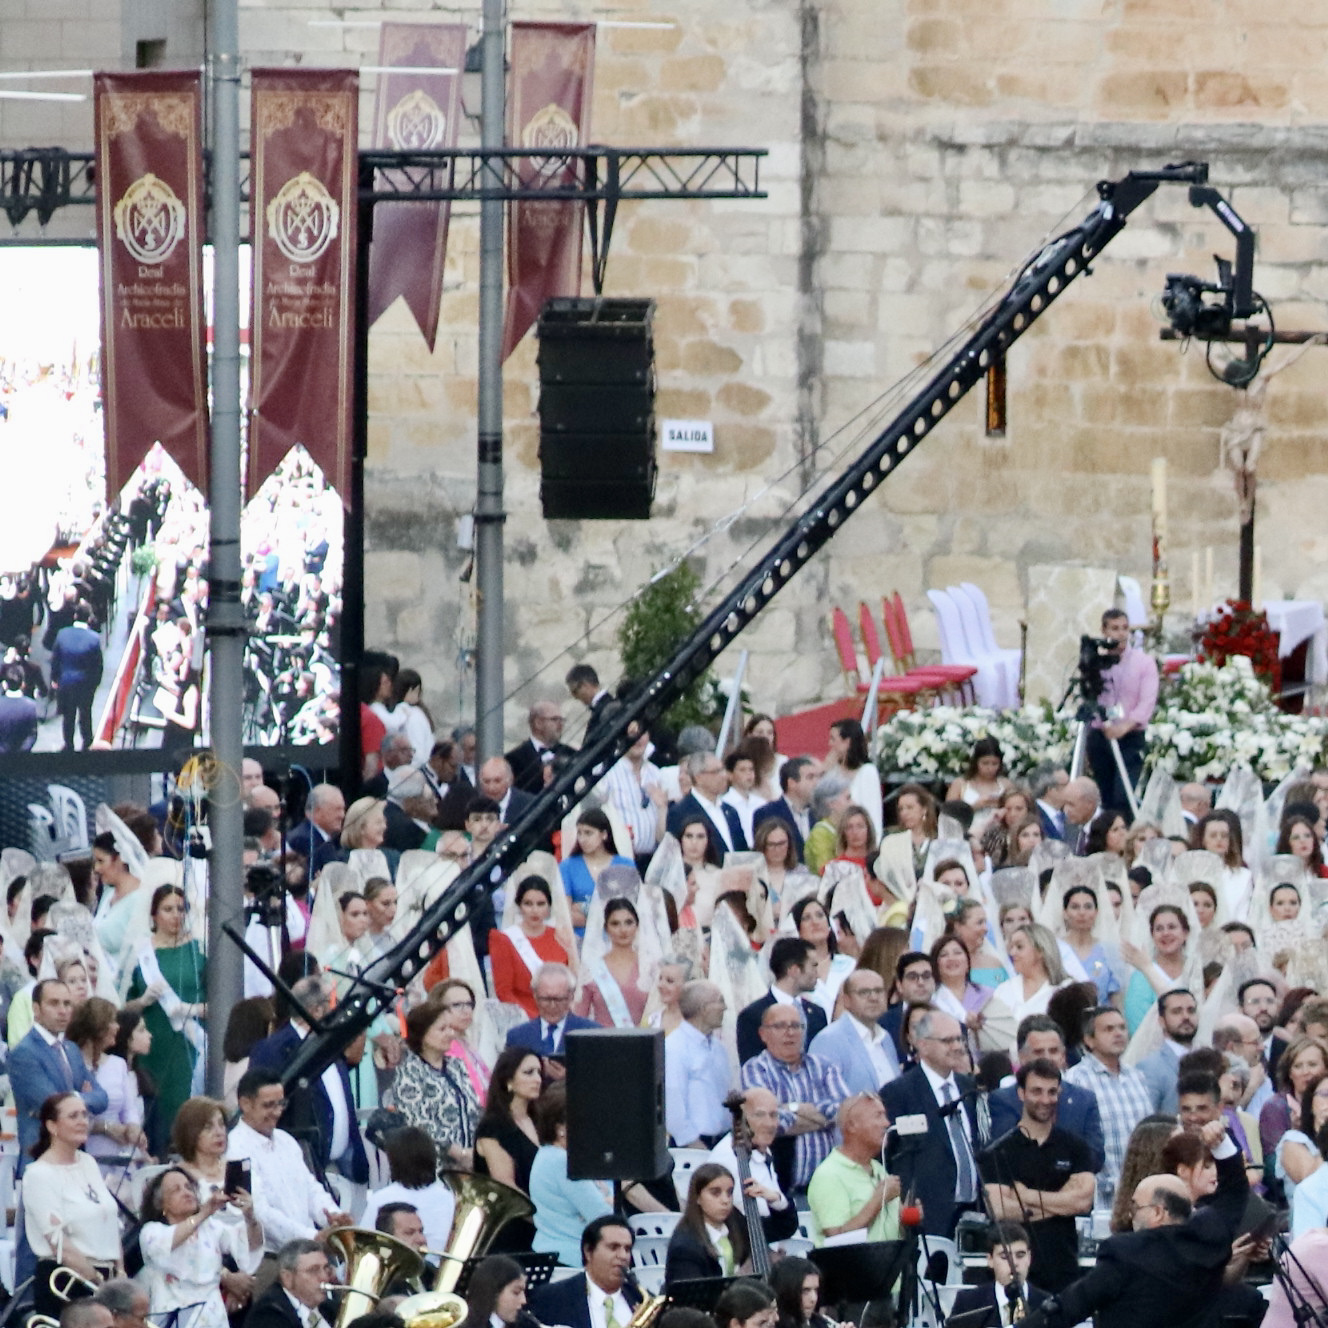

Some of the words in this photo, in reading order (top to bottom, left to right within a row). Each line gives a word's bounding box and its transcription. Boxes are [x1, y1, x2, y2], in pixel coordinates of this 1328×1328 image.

[138, 265, 164, 278] Real
[289, 264, 316, 278] Real
[120, 307, 185, 328] Araceli
[268, 306, 333, 328] Araceli
[669, 430, 708, 442] SALIDA
